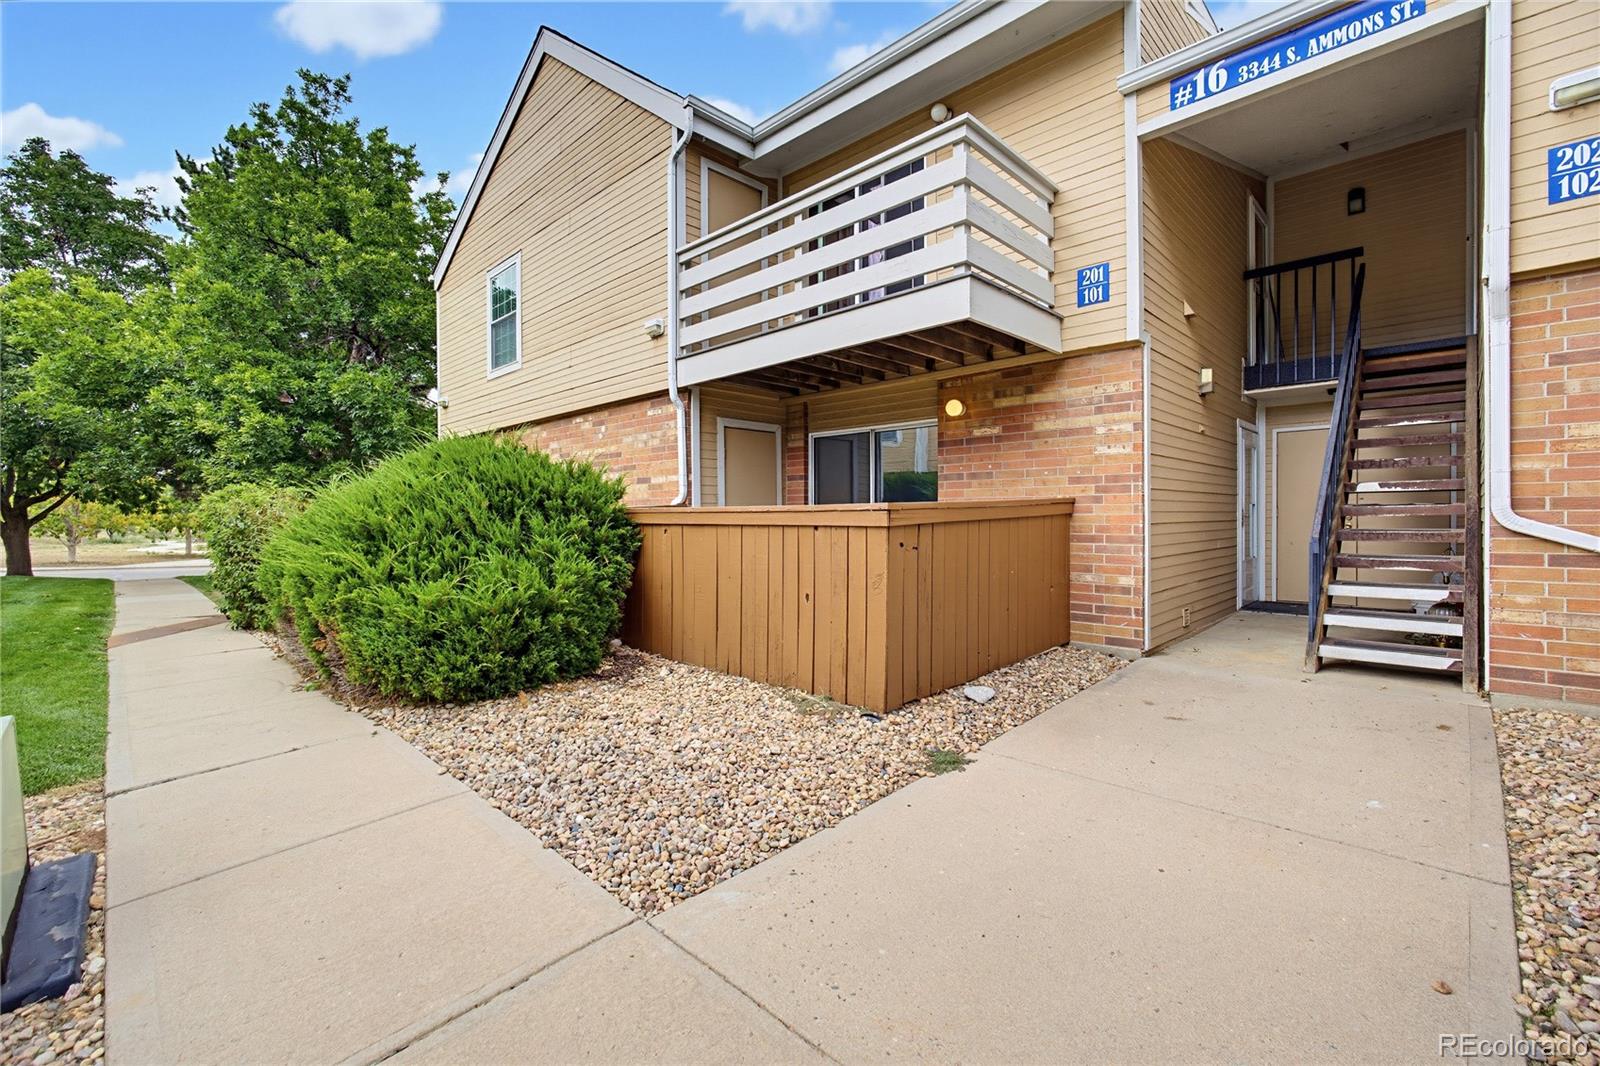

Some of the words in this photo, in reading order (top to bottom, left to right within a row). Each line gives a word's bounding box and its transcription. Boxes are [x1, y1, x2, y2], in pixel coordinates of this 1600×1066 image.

[1174, 60, 1228, 108] #16
[1238, 55, 1281, 82] 3344
[1286, 46, 1301, 65] S.
[1307, 11, 1385, 57] AMMONS
[1390, 0, 1419, 25] ST.
[1082, 265, 1104, 286] 201
[1083, 285, 1104, 304] 101
